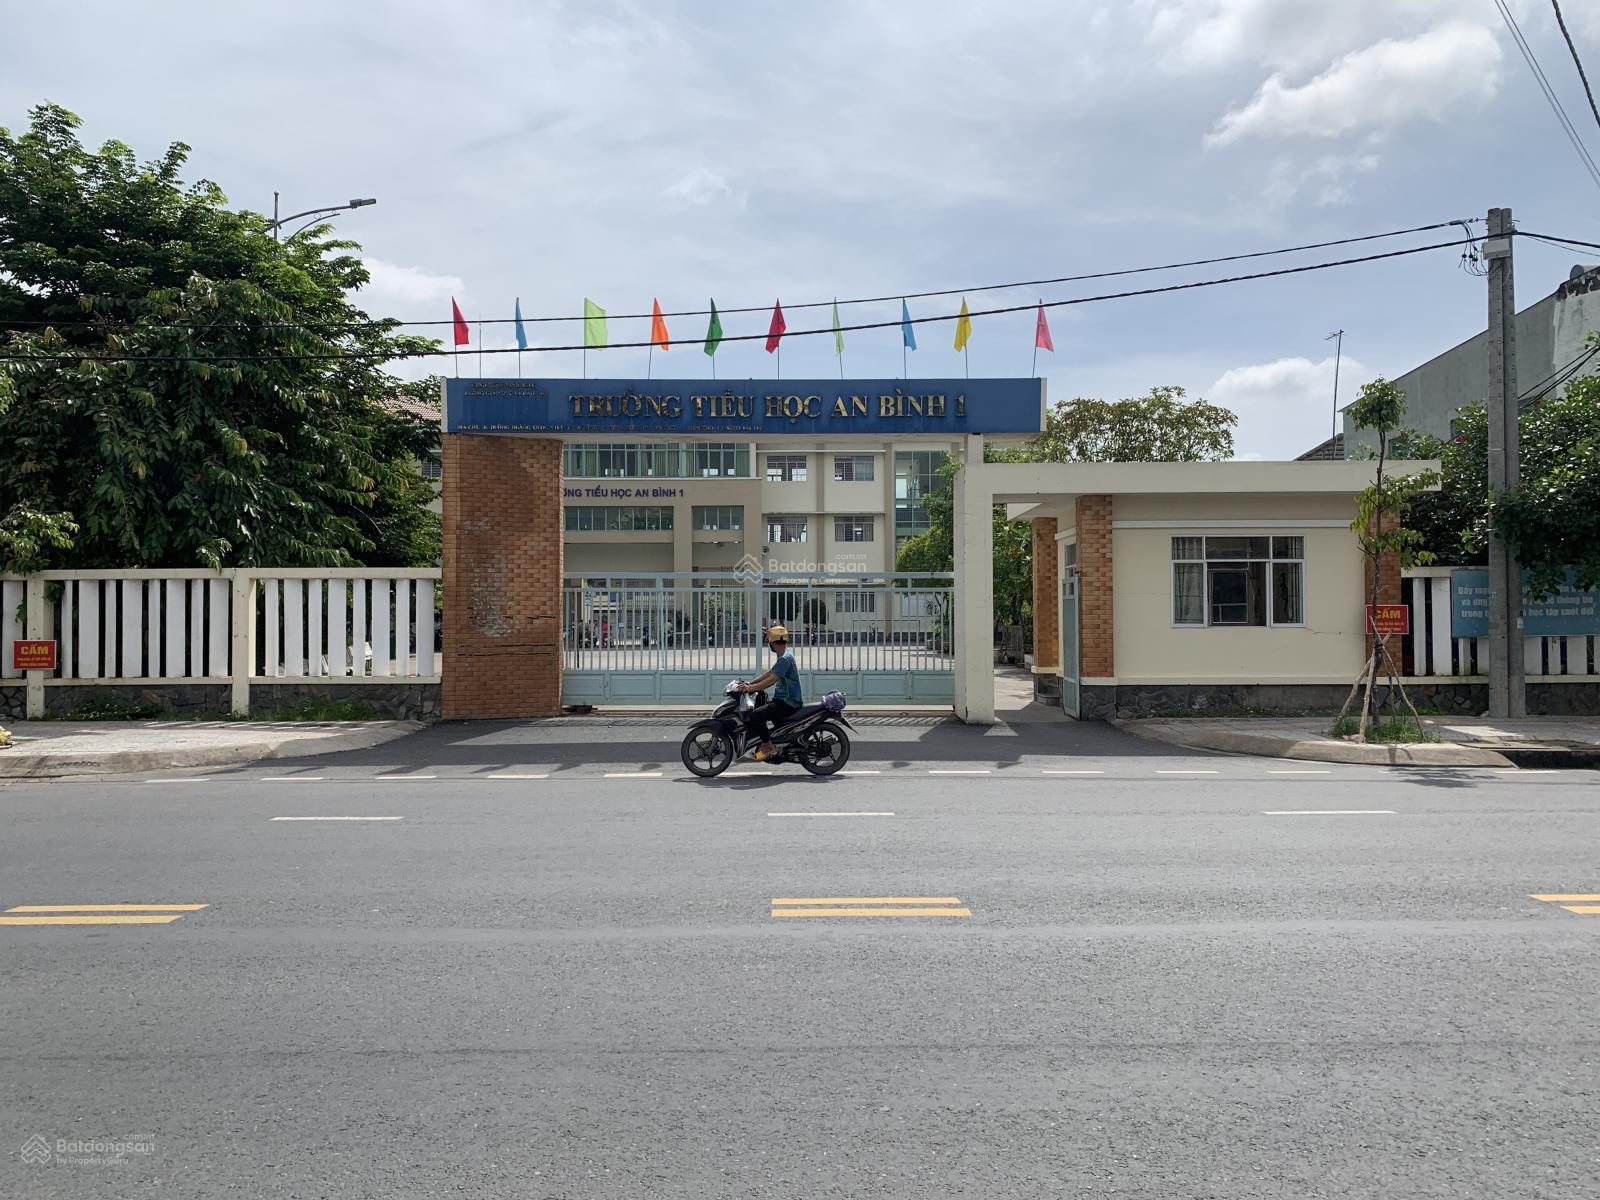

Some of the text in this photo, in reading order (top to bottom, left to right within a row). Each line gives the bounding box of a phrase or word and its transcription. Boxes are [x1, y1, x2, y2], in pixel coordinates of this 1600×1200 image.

[569, 386, 682, 417] TRƯỜNG
[764, 395, 822, 424] HỌC
[831, 395, 869, 417] AN
[879, 388, 946, 417] BÌNH
[955, 394, 967, 417] 1
[585, 485, 608, 498] TIỂU
[611, 488, 632, 499] HỌC
[635, 488, 649, 498] AN
[652, 486, 676, 498] BÌNH
[678, 488, 684, 498] 1
[20, 643, 49, 655] CẤM
